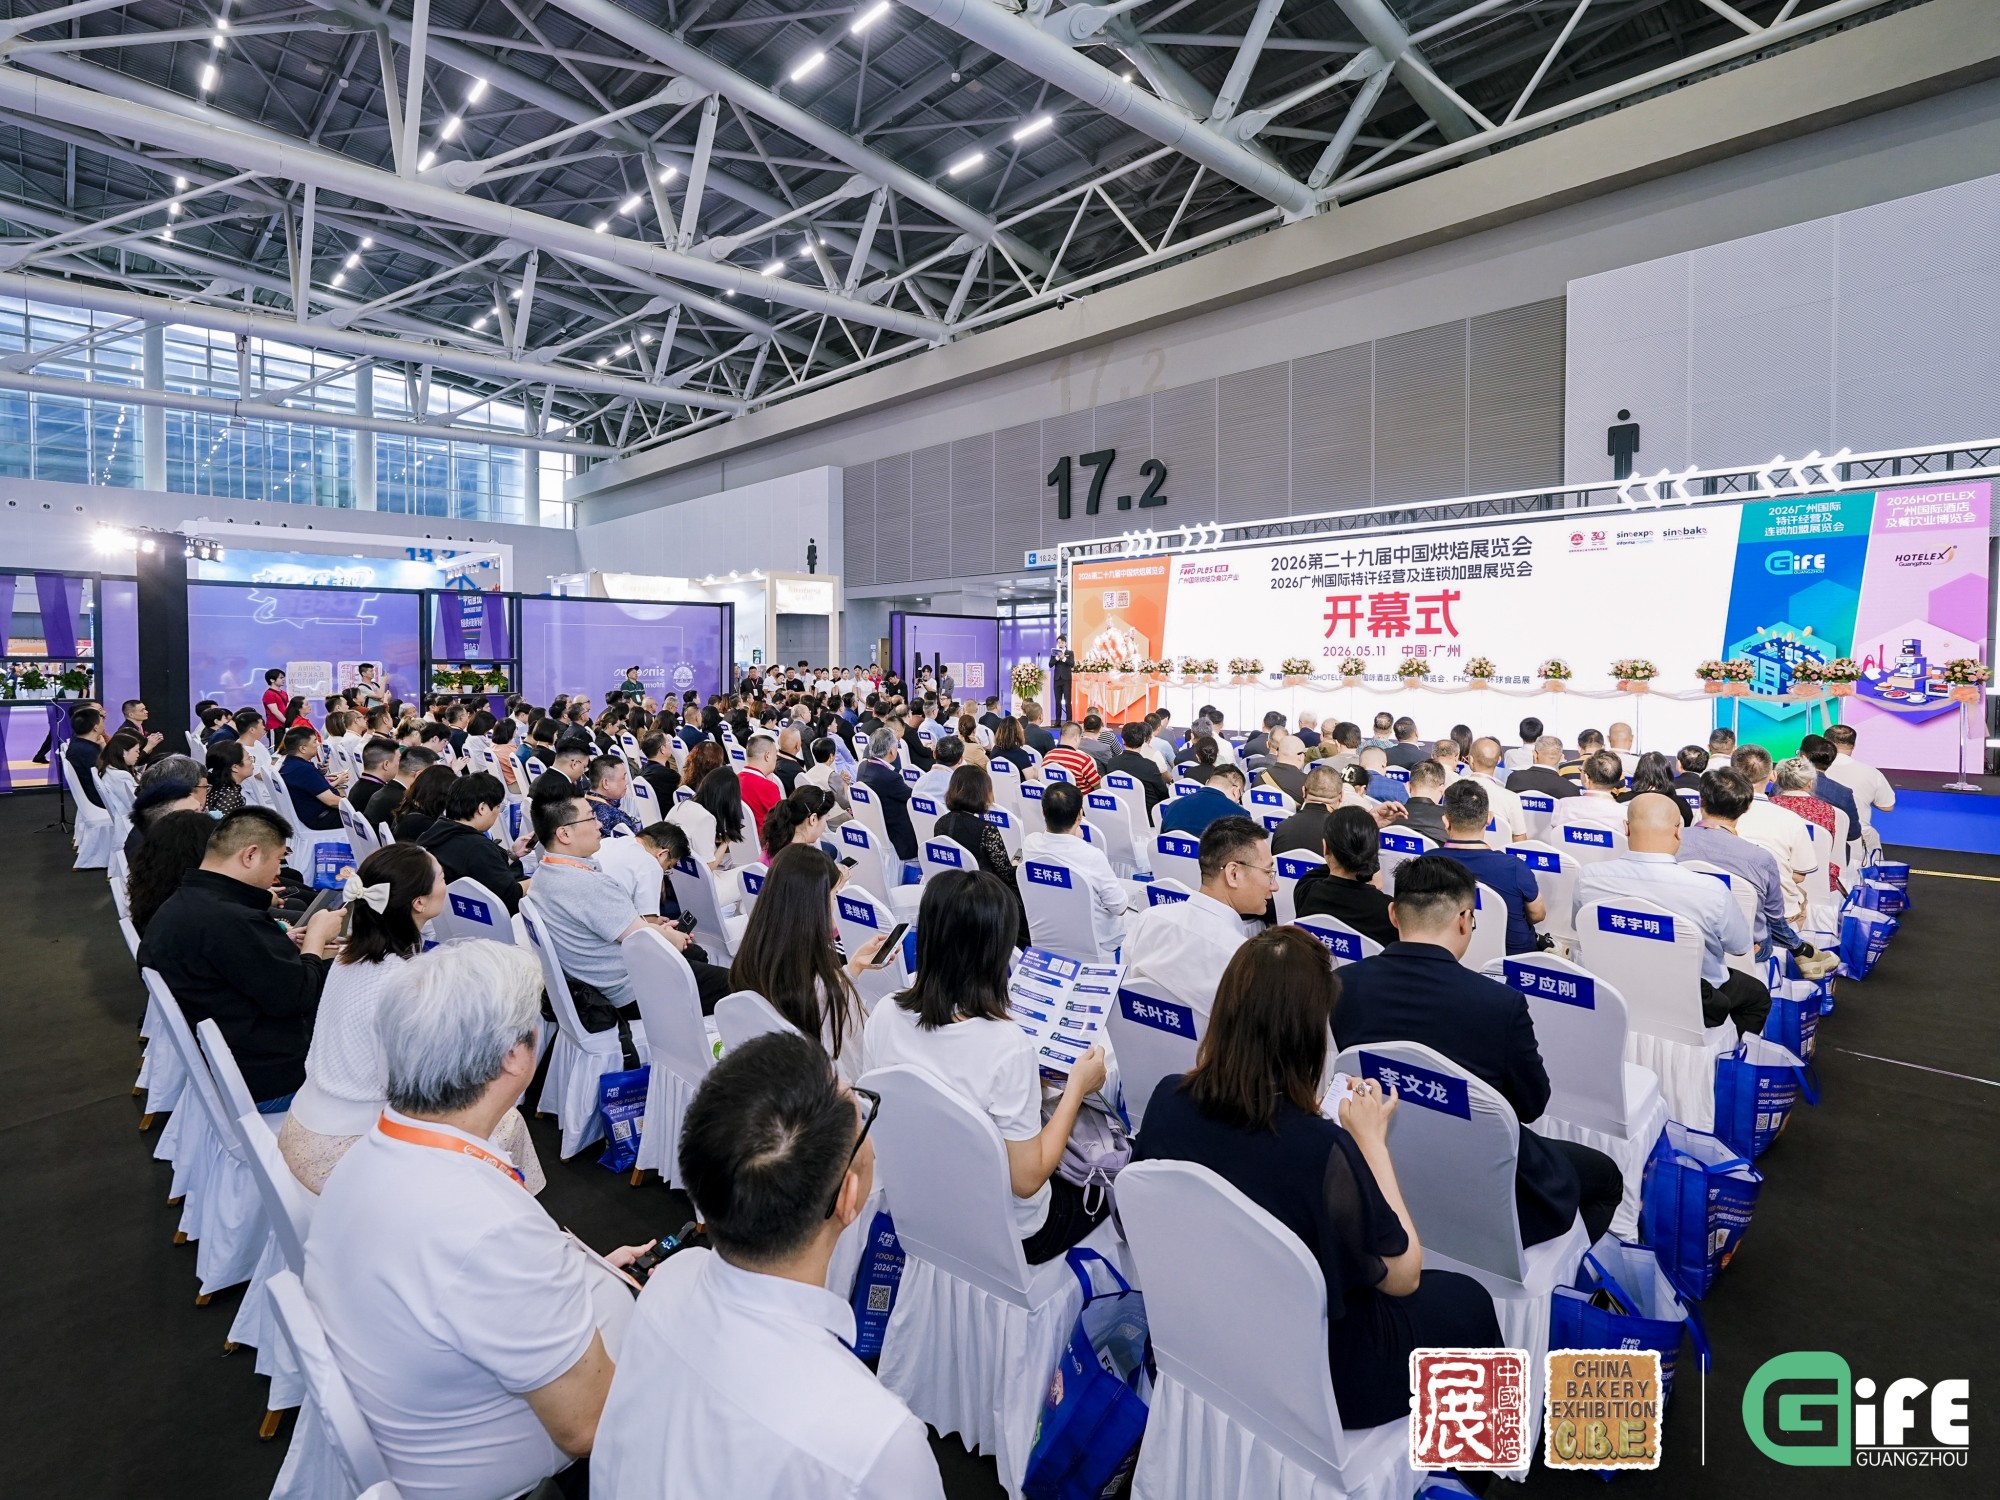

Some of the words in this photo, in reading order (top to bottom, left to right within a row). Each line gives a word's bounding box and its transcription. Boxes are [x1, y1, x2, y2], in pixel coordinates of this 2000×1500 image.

[1047, 449, 1168, 519] 17.2
[1887, 490, 1976, 507] 2026HOTELEX
[1769, 502, 1842, 516] 2026广州国际
[1892, 502, 1970, 517] 广州国际酒店
[1776, 513, 1833, 525] 特许经营及
[1885, 513, 1977, 528] 及餐饮业博览会
[1765, 522, 1845, 537] 连锁加盟展览会
[1271, 535, 1533, 572] 2026第二十九届中国烘焙展览会
[1895, 550, 1948, 562] HOTELEX
[1270, 560, 1533, 589] 2026广州国际特许经营及连锁加盟展览会
[1323, 589, 1461, 639] 开幕式
[1323, 645, 1386, 657] 2026.05.11
[1401, 644, 1461, 658] 中国·广州
[1034, 868, 1063, 883] 王怀兵
[844, 902, 870, 921] 梁继伟
[1611, 914, 1661, 935] 蒋宇明
[1519, 971, 1577, 998] 罗应刚
[1132, 1001, 1181, 1029] 朱叶茂
[1378, 1067, 1449, 1104] 李文龙
[875, 1252, 894, 1260] FOOD
